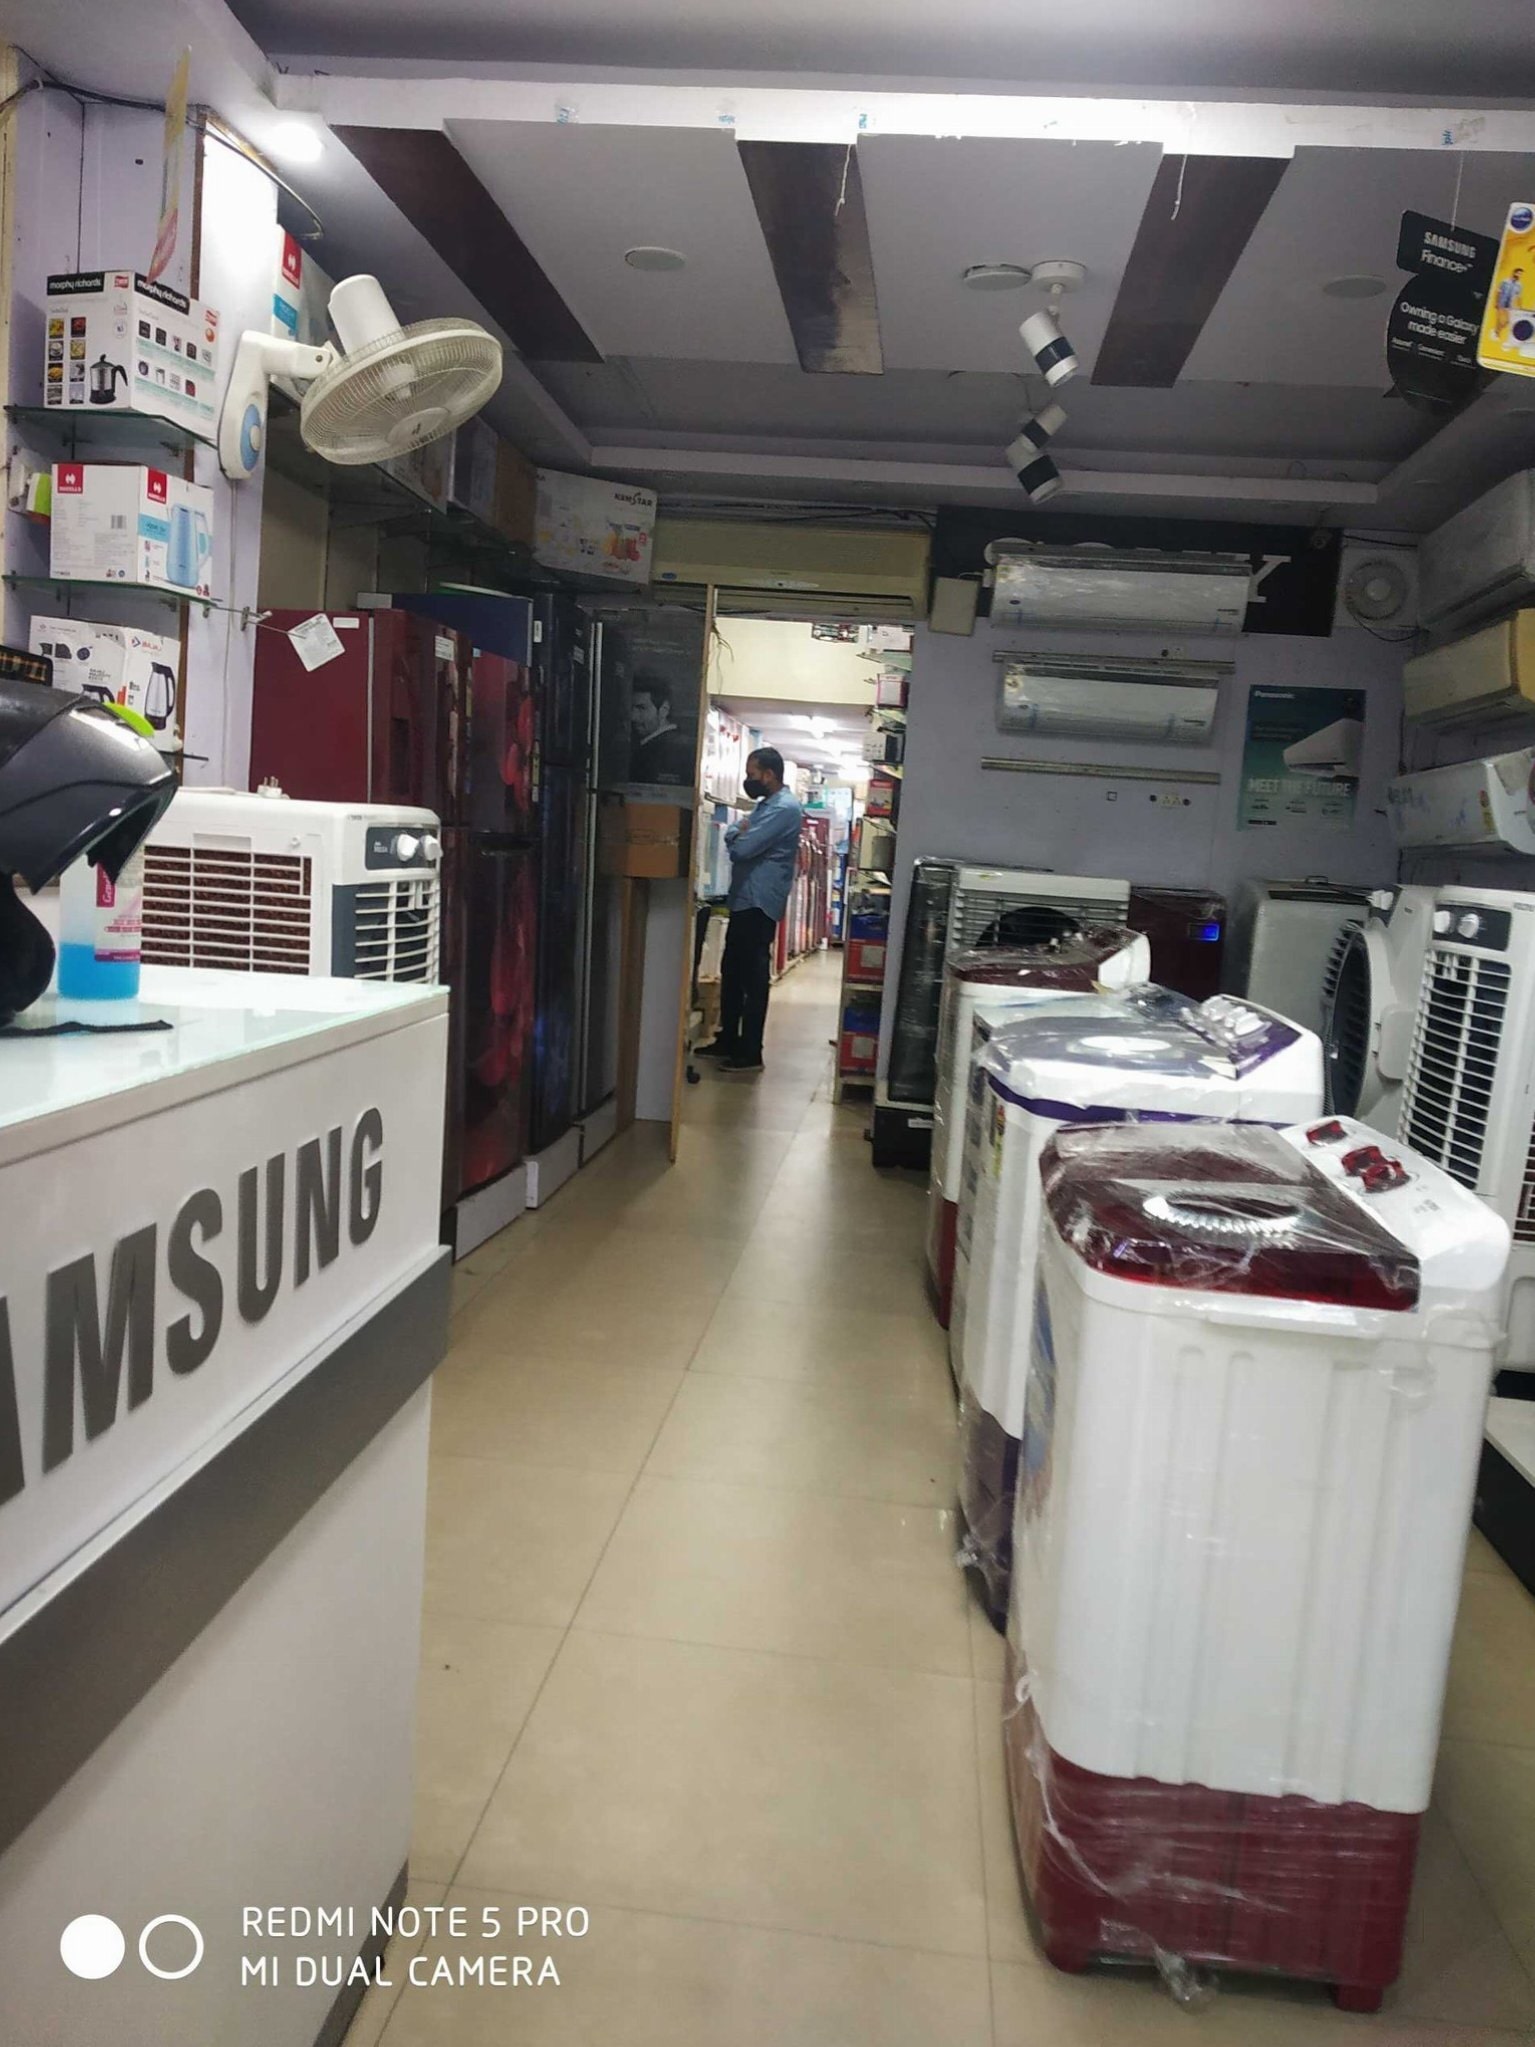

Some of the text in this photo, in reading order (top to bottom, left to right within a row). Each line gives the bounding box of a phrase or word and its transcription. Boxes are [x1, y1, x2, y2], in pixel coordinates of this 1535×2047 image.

[1423, 231, 1477, 258] SAMSUNG
[50, 278, 102, 290] morphy richards
[137, 279, 162, 299] morphy
[162, 290, 187, 309] richards
[1401, 302, 1479, 336] Owning a Galaxy
[1408, 321, 1468, 345] made easier
[1247, 778, 1352, 797] MEET THE FUTURE
